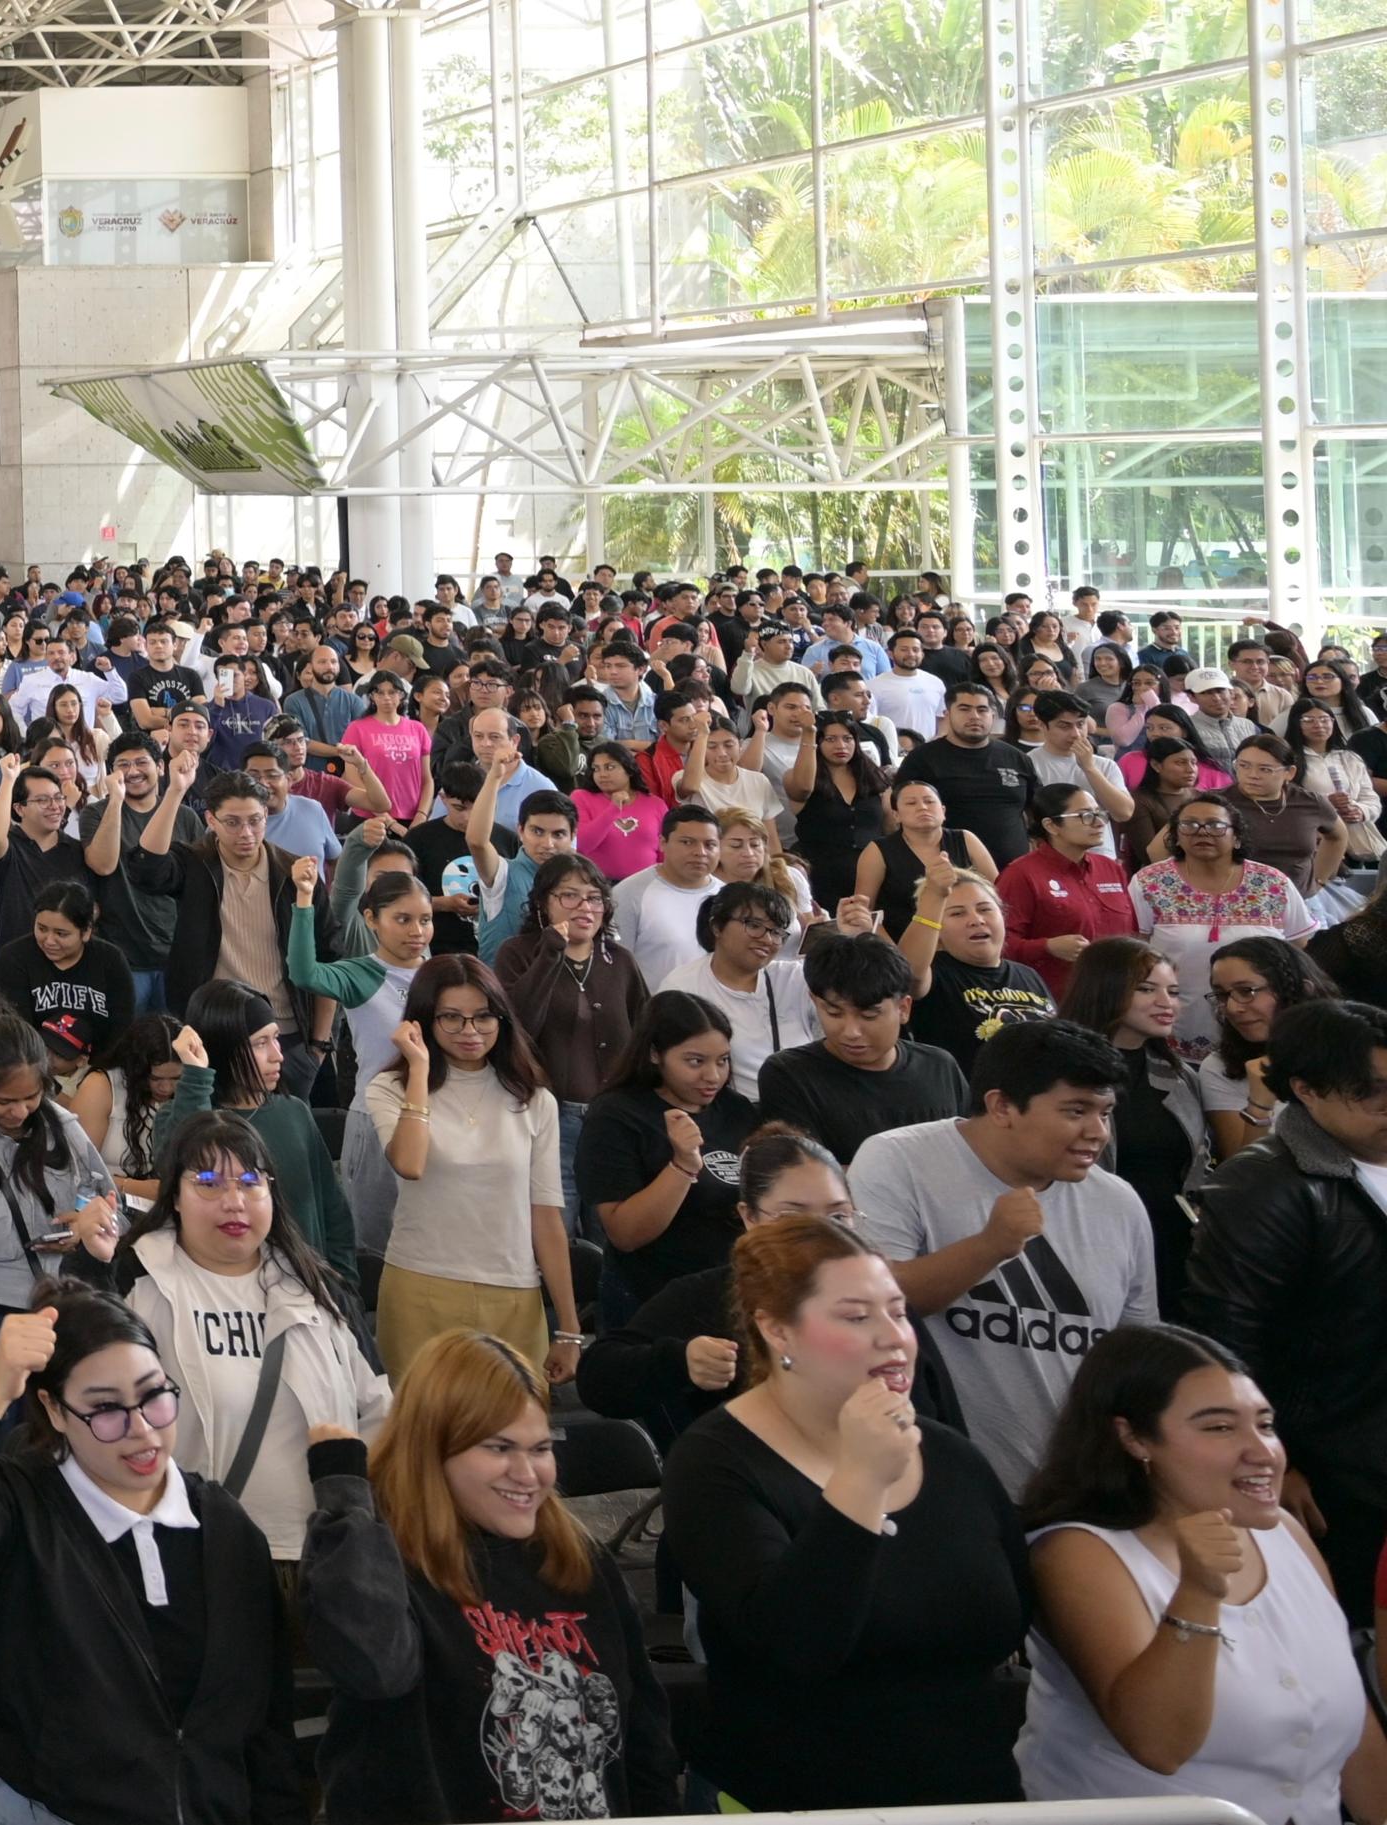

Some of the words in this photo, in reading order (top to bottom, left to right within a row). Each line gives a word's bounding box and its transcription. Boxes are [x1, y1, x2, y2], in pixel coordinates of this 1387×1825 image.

[91, 217, 143, 225] VERACRUZ
[31, 981, 109, 1018] WIFE
[945, 1304, 1109, 1356] adidas
